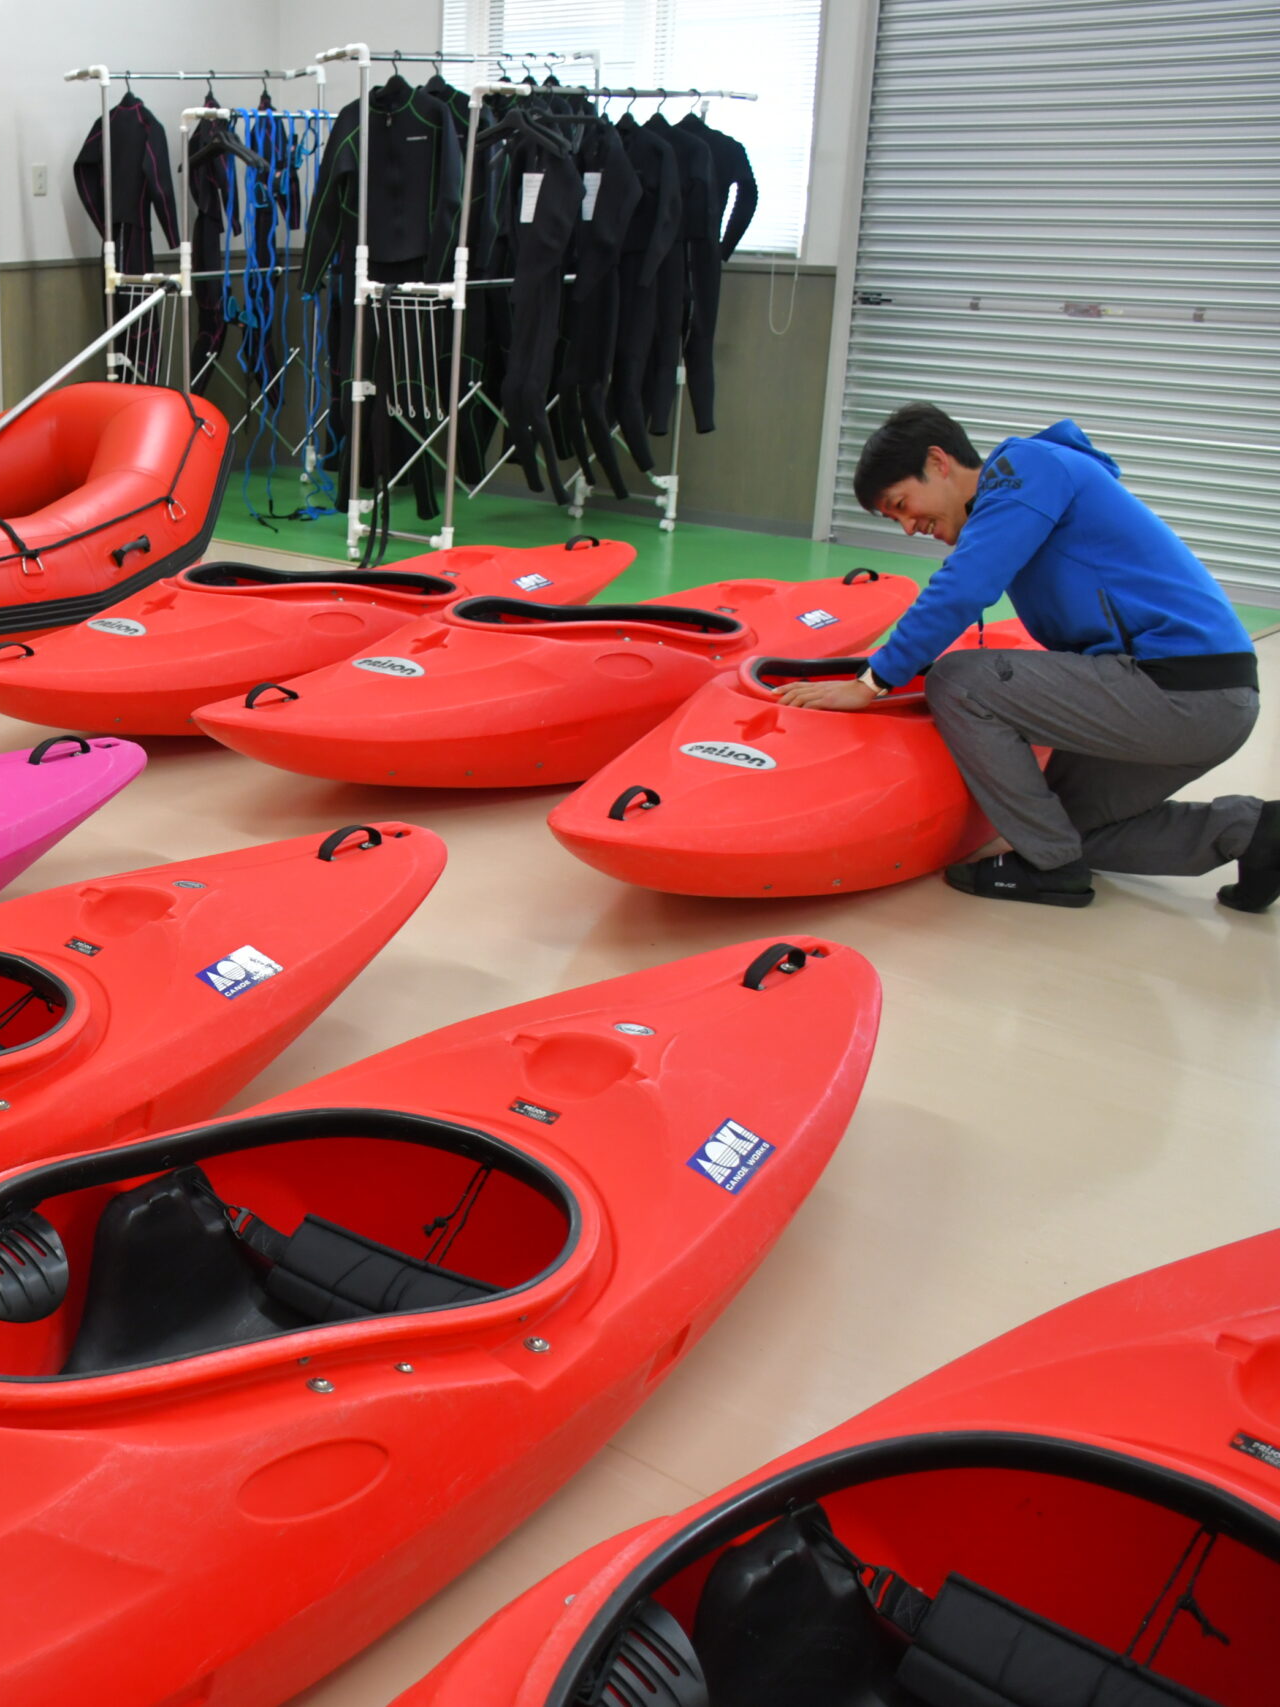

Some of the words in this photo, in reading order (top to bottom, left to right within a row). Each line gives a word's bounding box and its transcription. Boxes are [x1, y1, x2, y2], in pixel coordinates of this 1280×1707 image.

[695, 1119, 760, 1185] AOKI
[724, 1166, 749, 1191] CANOE
[746, 1141, 770, 1166] WORKS
